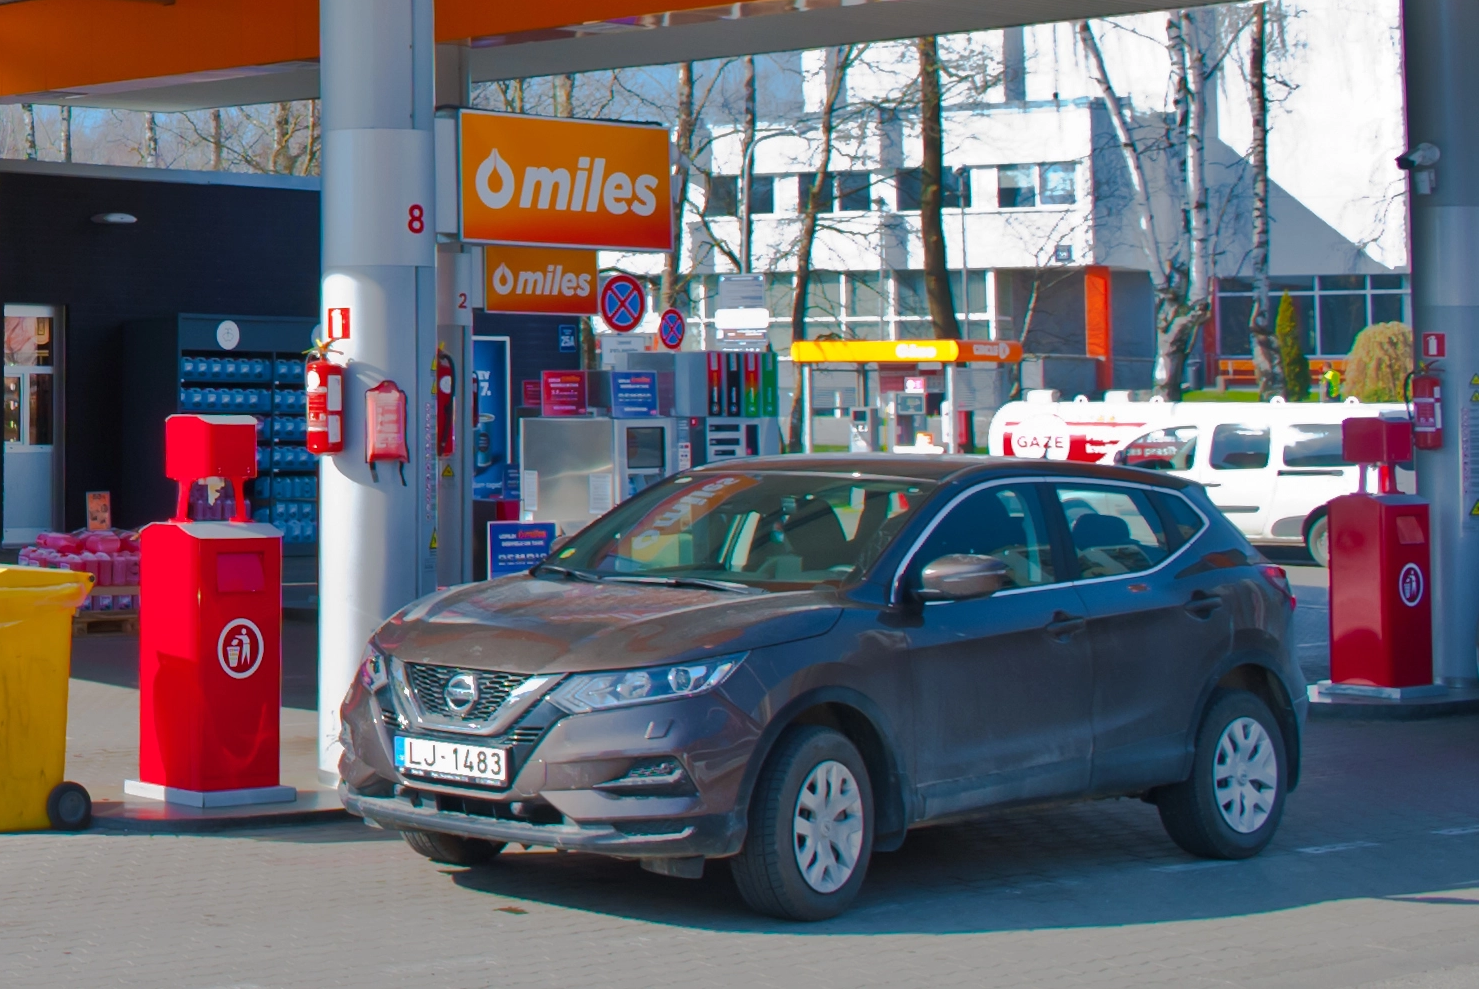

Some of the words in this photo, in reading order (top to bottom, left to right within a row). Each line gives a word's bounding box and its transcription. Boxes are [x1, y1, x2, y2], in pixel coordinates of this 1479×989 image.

[519, 156, 659, 217] miles
[408, 203, 425, 234] 8
[515, 264, 592, 297] miles
[457, 292, 468, 309] 2
[408, 740, 502, 776] LJ-1483
